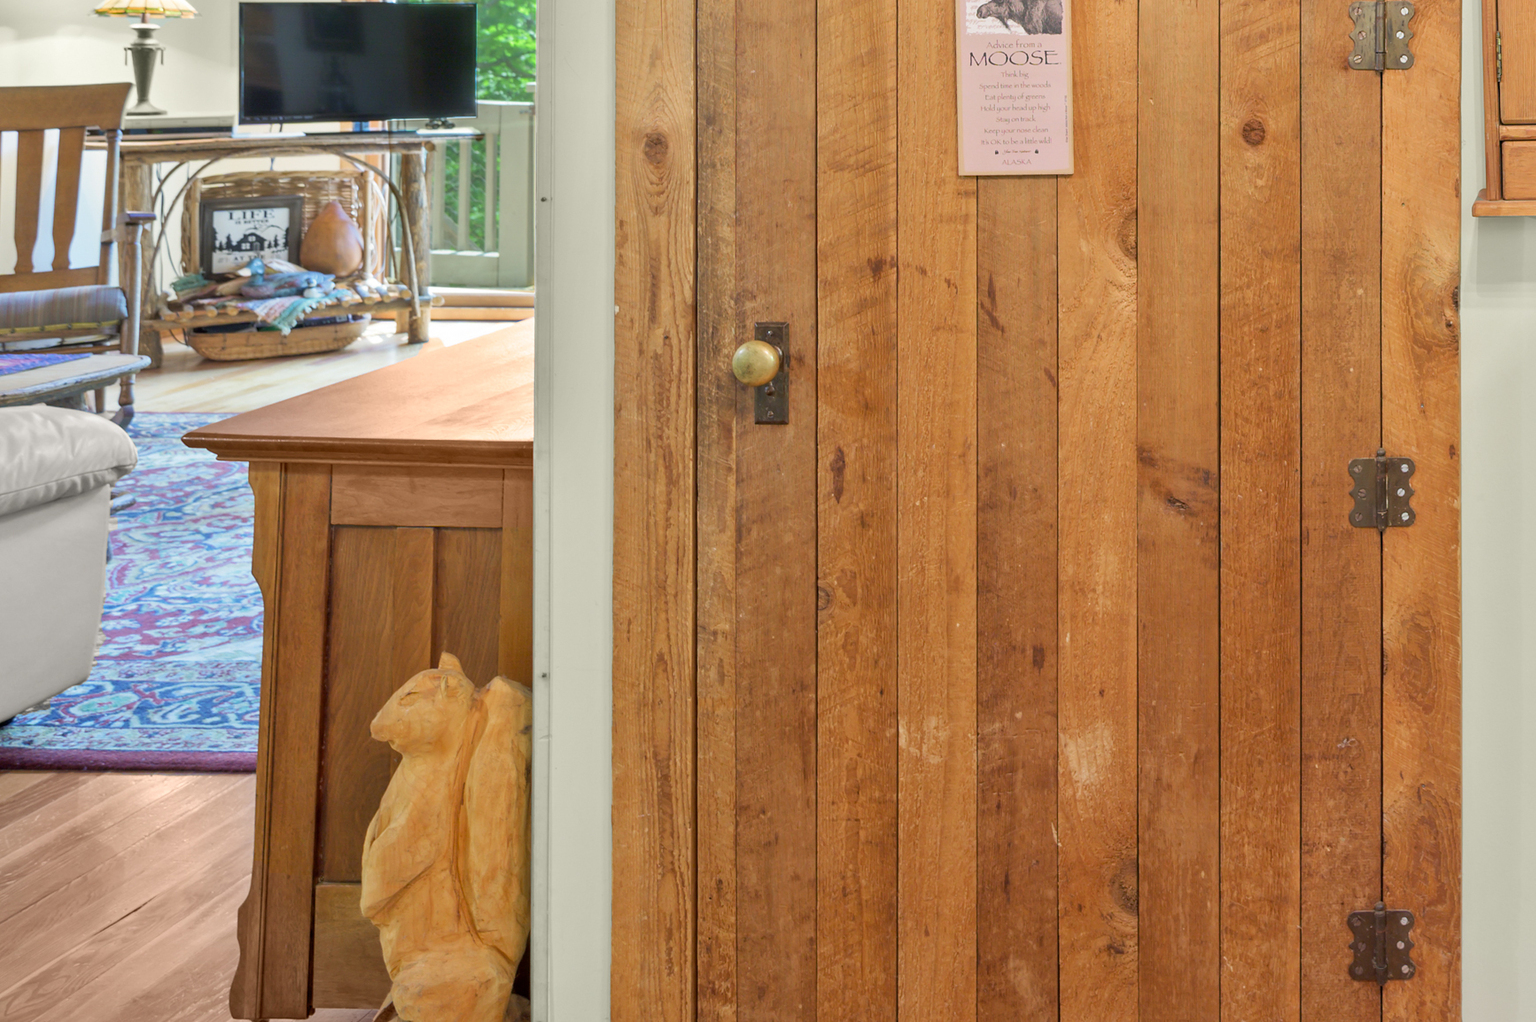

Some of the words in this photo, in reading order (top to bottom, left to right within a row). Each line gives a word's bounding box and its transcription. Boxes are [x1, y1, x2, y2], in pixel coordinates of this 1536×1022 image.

[986, 39, 1014, 49] Advice
[1015, 38, 1036, 48] from
[969, 50, 1059, 66] MOOSE
[1000, 70, 1018, 78] Think
[979, 81, 1000, 92] Spend
[1020, 81, 1030, 89] the
[1031, 80, 1052, 88] woods
[997, 93, 1017, 103] plenty
[1017, 92, 1024, 100] of
[1025, 94, 1046, 102] greens
[980, 103, 996, 111] Hold
[996, 106, 1011, 114] your
[1011, 103, 1028, 111] head
[1028, 106, 1037, 114] up
[1037, 103, 1051, 113] high
[995, 117, 1011, 125] Stay
[1020, 114, 1036, 122] track
[983, 128, 1001, 136] Keep
[1001, 128, 1015, 136] your
[1032, 125, 1049, 133] clean
[1010, 137, 1018, 145] be
[228, 208, 275, 220] LIFE
